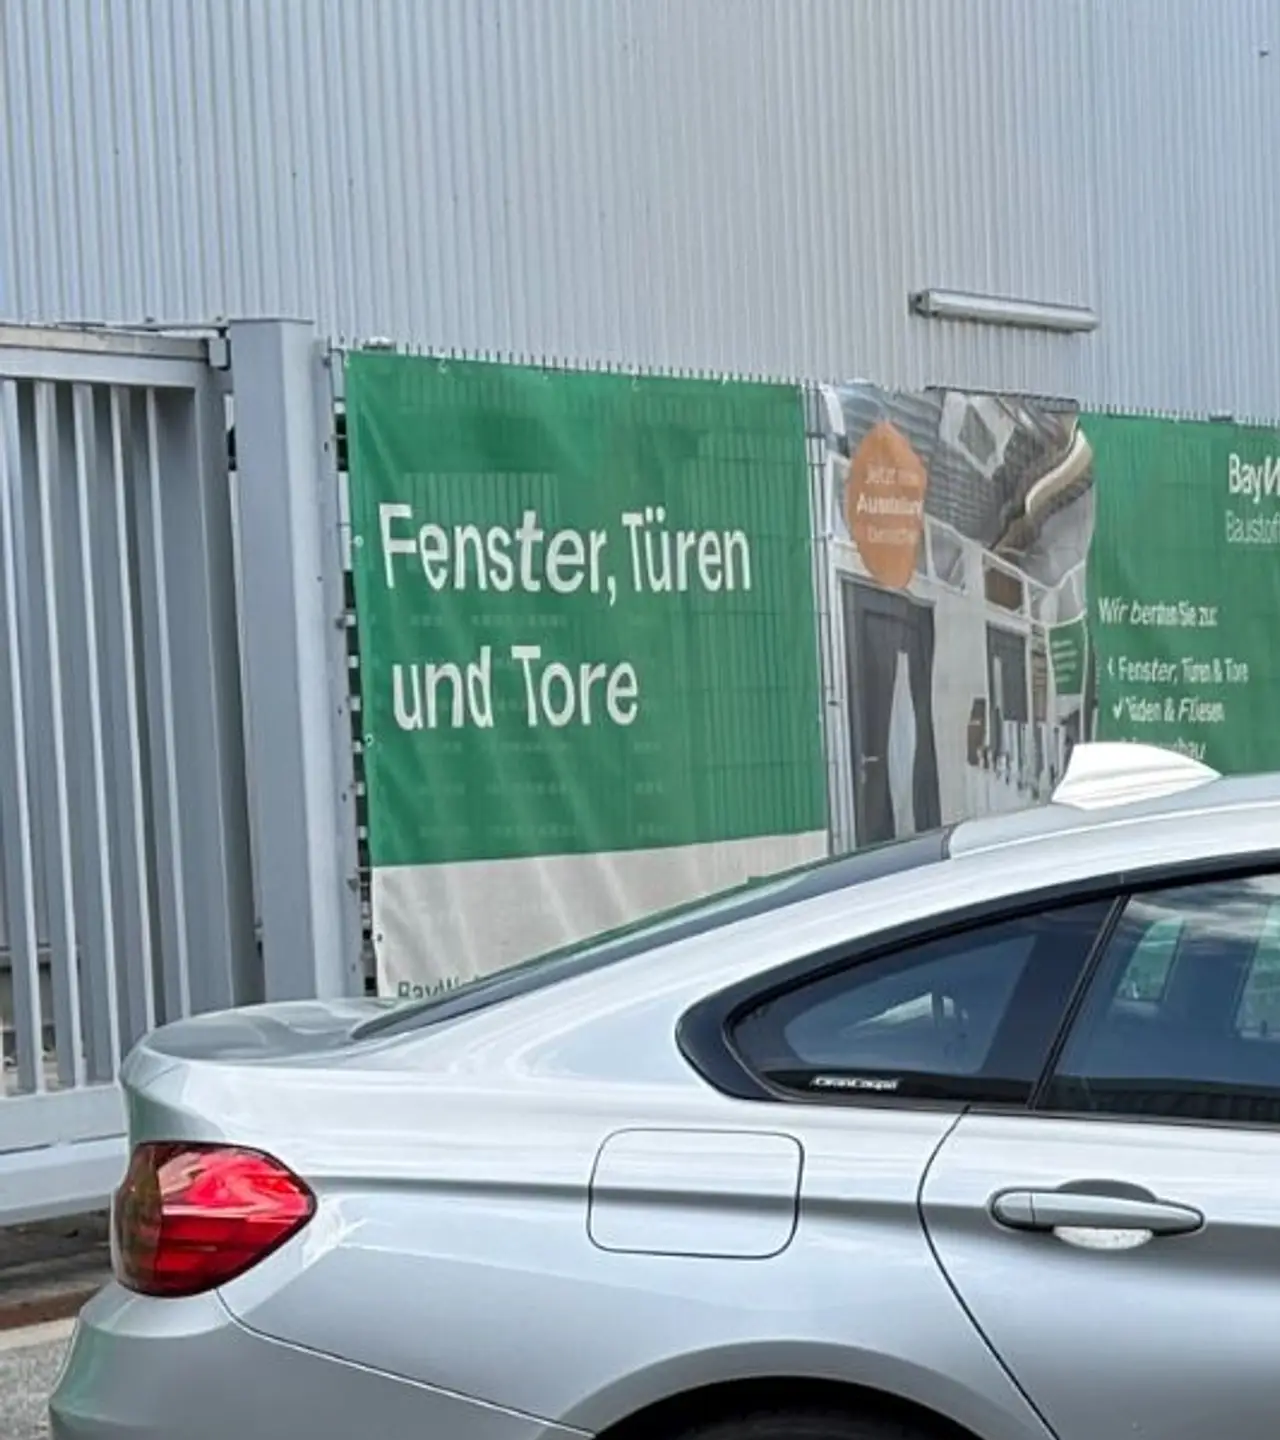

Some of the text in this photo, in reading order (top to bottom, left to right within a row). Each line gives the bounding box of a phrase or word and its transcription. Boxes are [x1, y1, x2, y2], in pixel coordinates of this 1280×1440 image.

[379, 502, 751, 606] Fenster, Türen
[1098, 596, 1129, 624] Wir
[391, 644, 639, 731] und Tore
[1118, 656, 1178, 686] Fenster,
